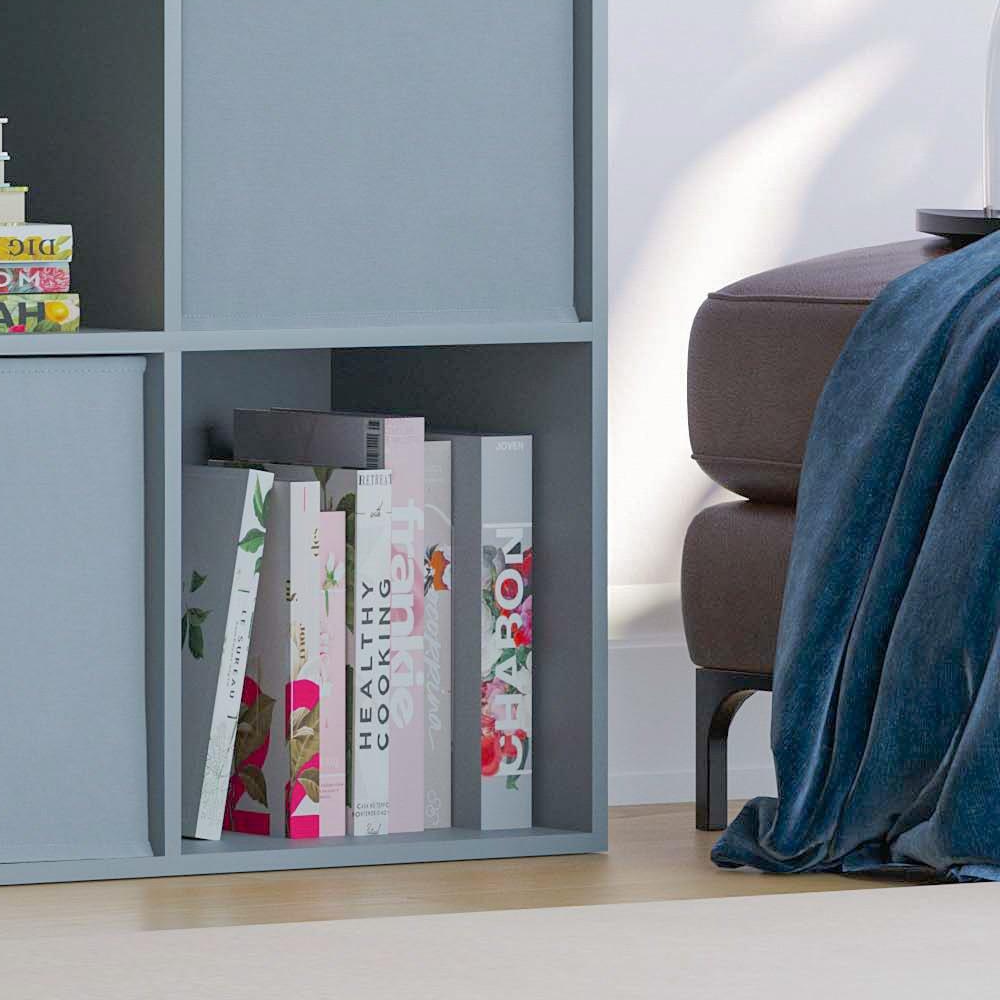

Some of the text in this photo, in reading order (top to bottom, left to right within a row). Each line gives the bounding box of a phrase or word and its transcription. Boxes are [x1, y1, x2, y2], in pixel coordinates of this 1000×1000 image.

[8, 238, 56, 256] DIG
[359, 581, 374, 750] HEALTHY
[377, 578, 391, 751] COOKING
[391, 497, 424, 730] frankie
[495, 527, 525, 773] CHABON
